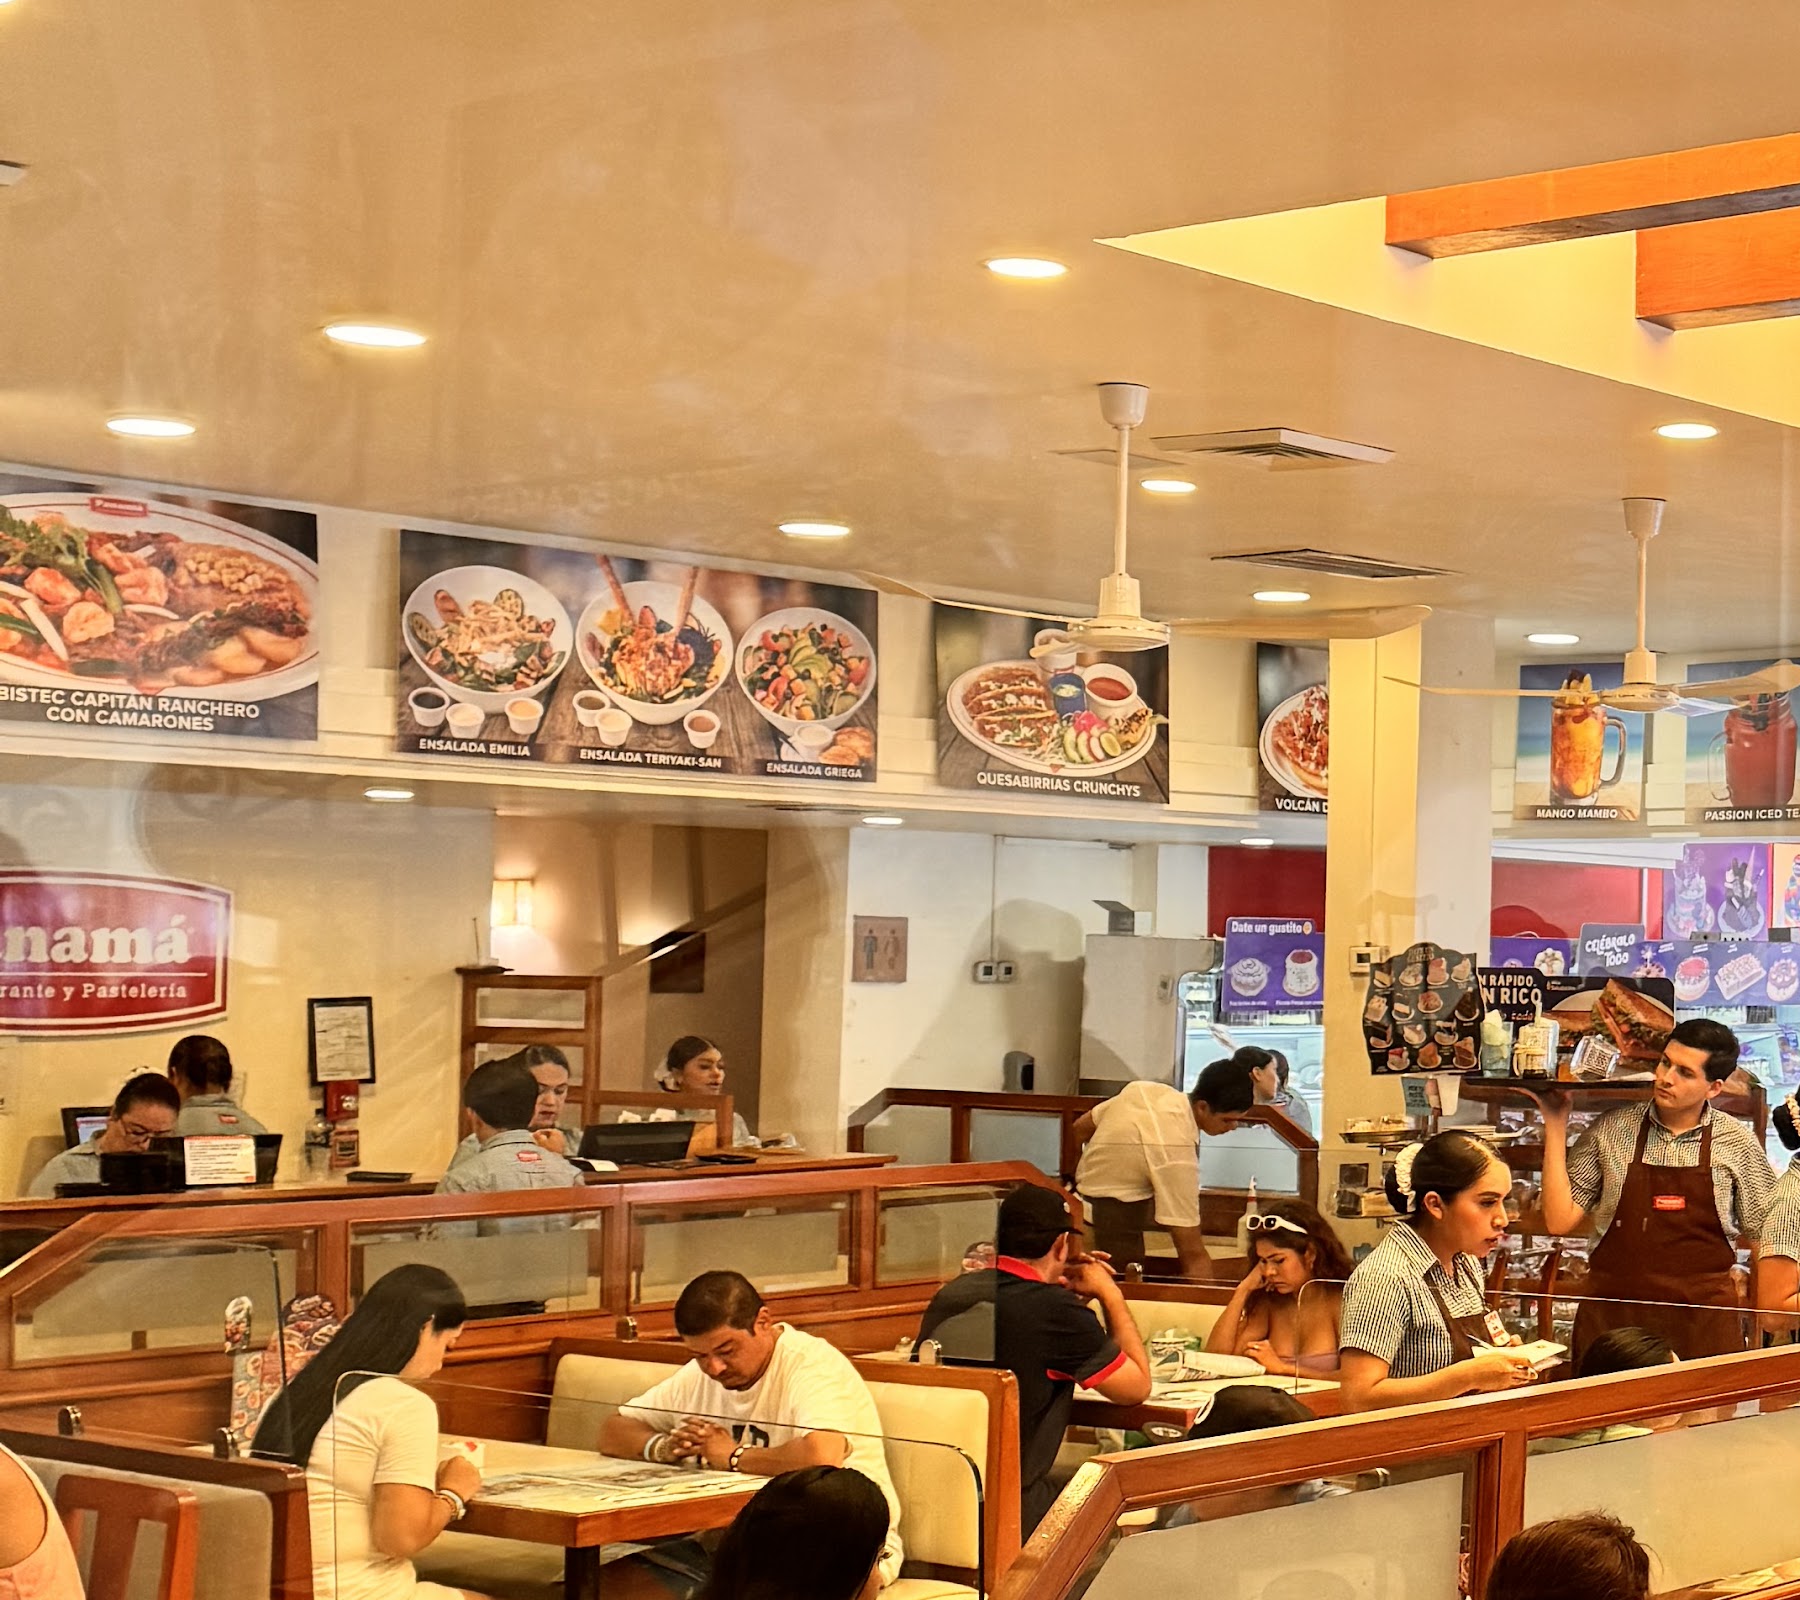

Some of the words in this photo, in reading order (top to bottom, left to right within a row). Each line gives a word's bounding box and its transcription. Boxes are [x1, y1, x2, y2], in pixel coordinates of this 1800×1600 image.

[0, 688, 65, 705] BISTEC
[158, 699, 260, 718] RANCHERO
[46, 707, 89, 723] CON
[95, 710, 214, 731] CAMARONES
[419, 739, 486, 755] ENSALADA
[490, 743, 531, 758] EMILIA
[579, 749, 643, 764] ENSALADA
[646, 752, 722, 769] TERIYAKI-SAN
[766, 763, 823, 776] ENSALADA
[825, 766, 863, 779] GRIEGA
[976, 771, 1071, 792] QUESABIRRIAS
[1073, 780, 1141, 798] CRUNCHYS
[1275, 797, 1319, 813] VOLCÁN
[1536, 808, 1576, 819] MANGO
[1577, 808, 1618, 819] MAMBO
[1704, 809, 1753, 821] PASSION
[1755, 808, 1782, 820] ICED
[1231, 921, 1253, 933] Date
[1255, 925, 1267, 933] un
[1269, 921, 1303, 936] gustito
[0, 914, 190, 964] namá
[1604, 952, 1629, 967] TODO
[62, 986, 75, 1002] y
[82, 983, 187, 999] Pastelería
[1500, 988, 1542, 1005] RICO
